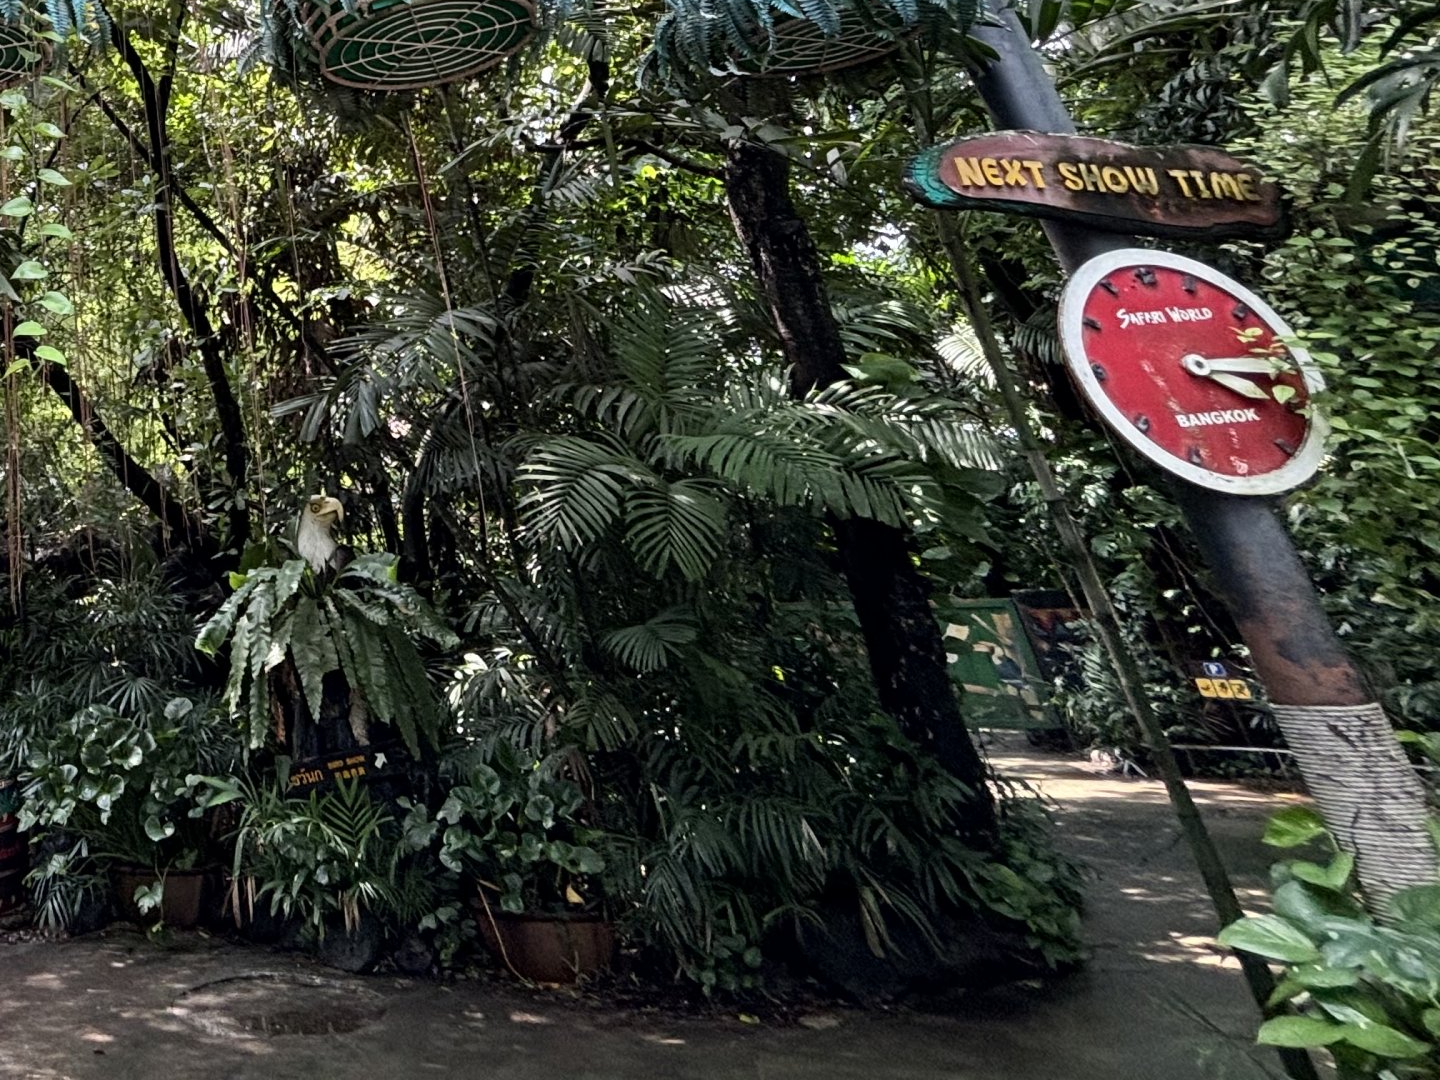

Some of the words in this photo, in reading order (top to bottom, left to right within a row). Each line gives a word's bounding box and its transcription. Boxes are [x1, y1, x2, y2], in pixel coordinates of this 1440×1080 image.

[953, 156, 1048, 189] NEXT
[1057, 161, 1160, 196] SHOW
[1168, 169, 1262, 202] TIME
[1175, 408, 1261, 428] BANGKOK
